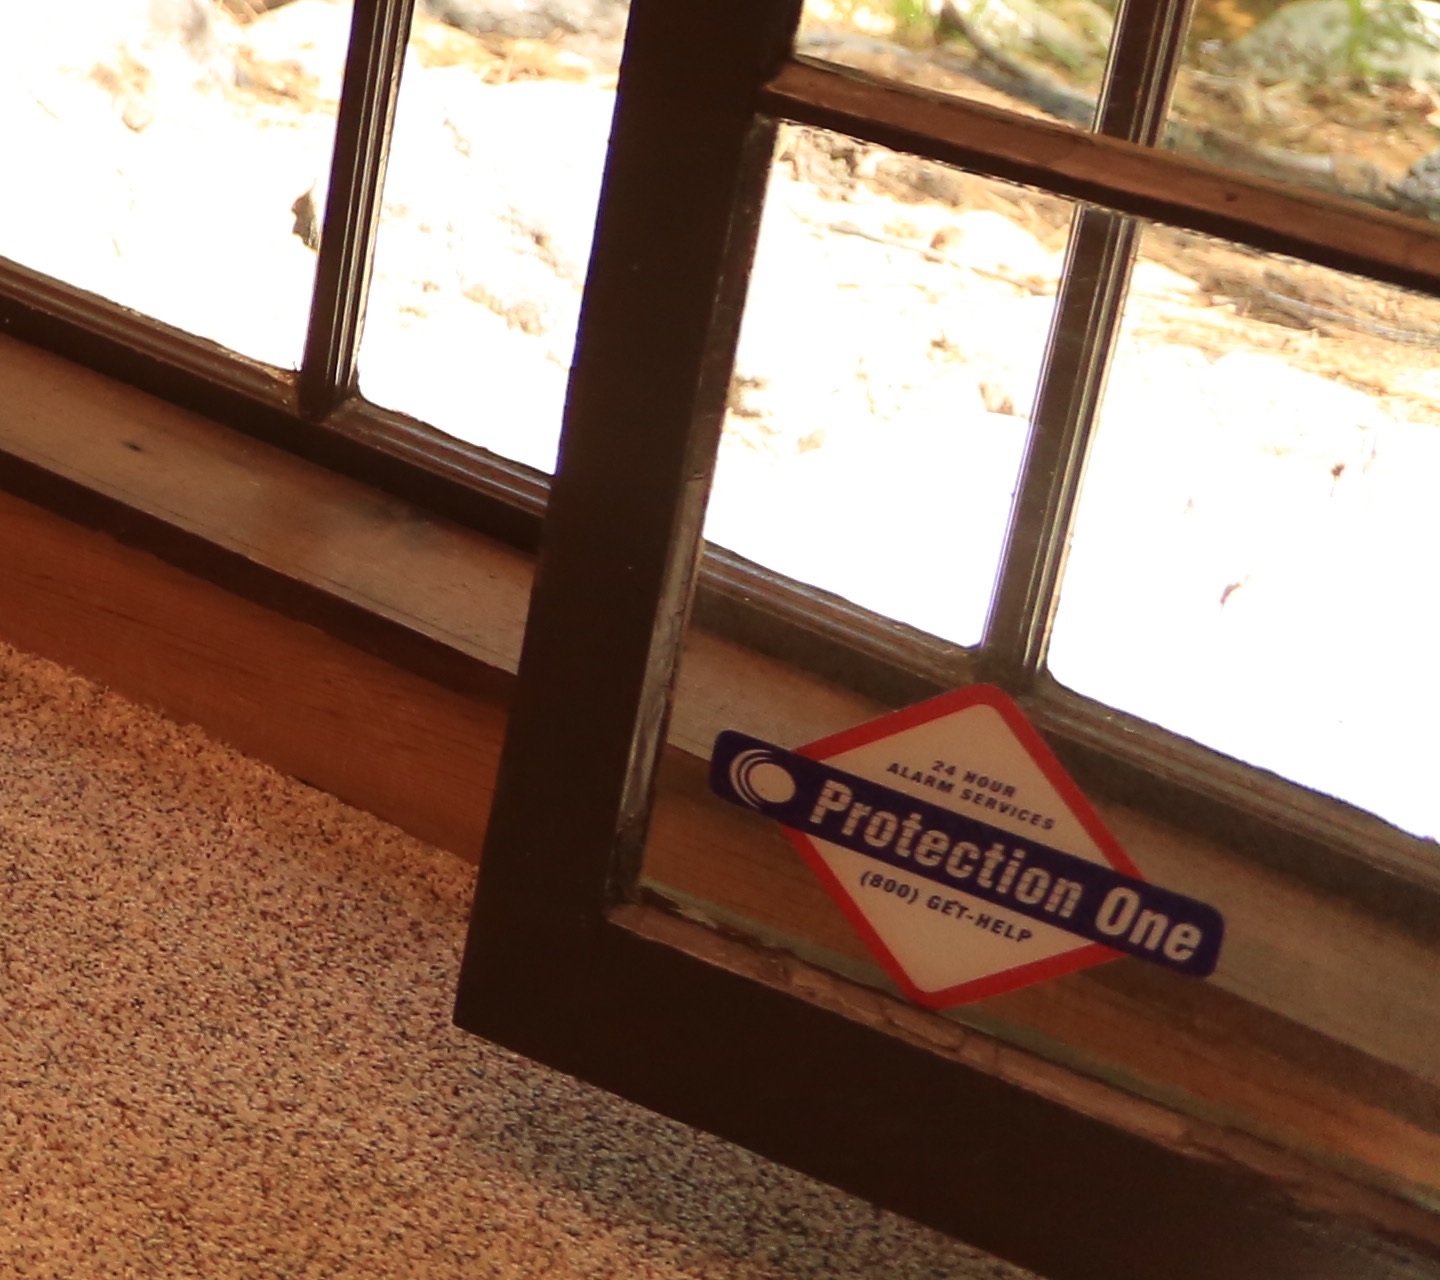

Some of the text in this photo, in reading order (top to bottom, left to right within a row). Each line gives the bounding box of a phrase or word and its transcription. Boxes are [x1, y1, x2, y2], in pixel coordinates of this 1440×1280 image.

[885, 762, 1057, 831] ALARM SERVICES
[931, 760, 1017, 799] 24 HOUR
[809, 779, 1203, 963] Protection One
[860, 870, 1034, 943] (800) GET-HELP
